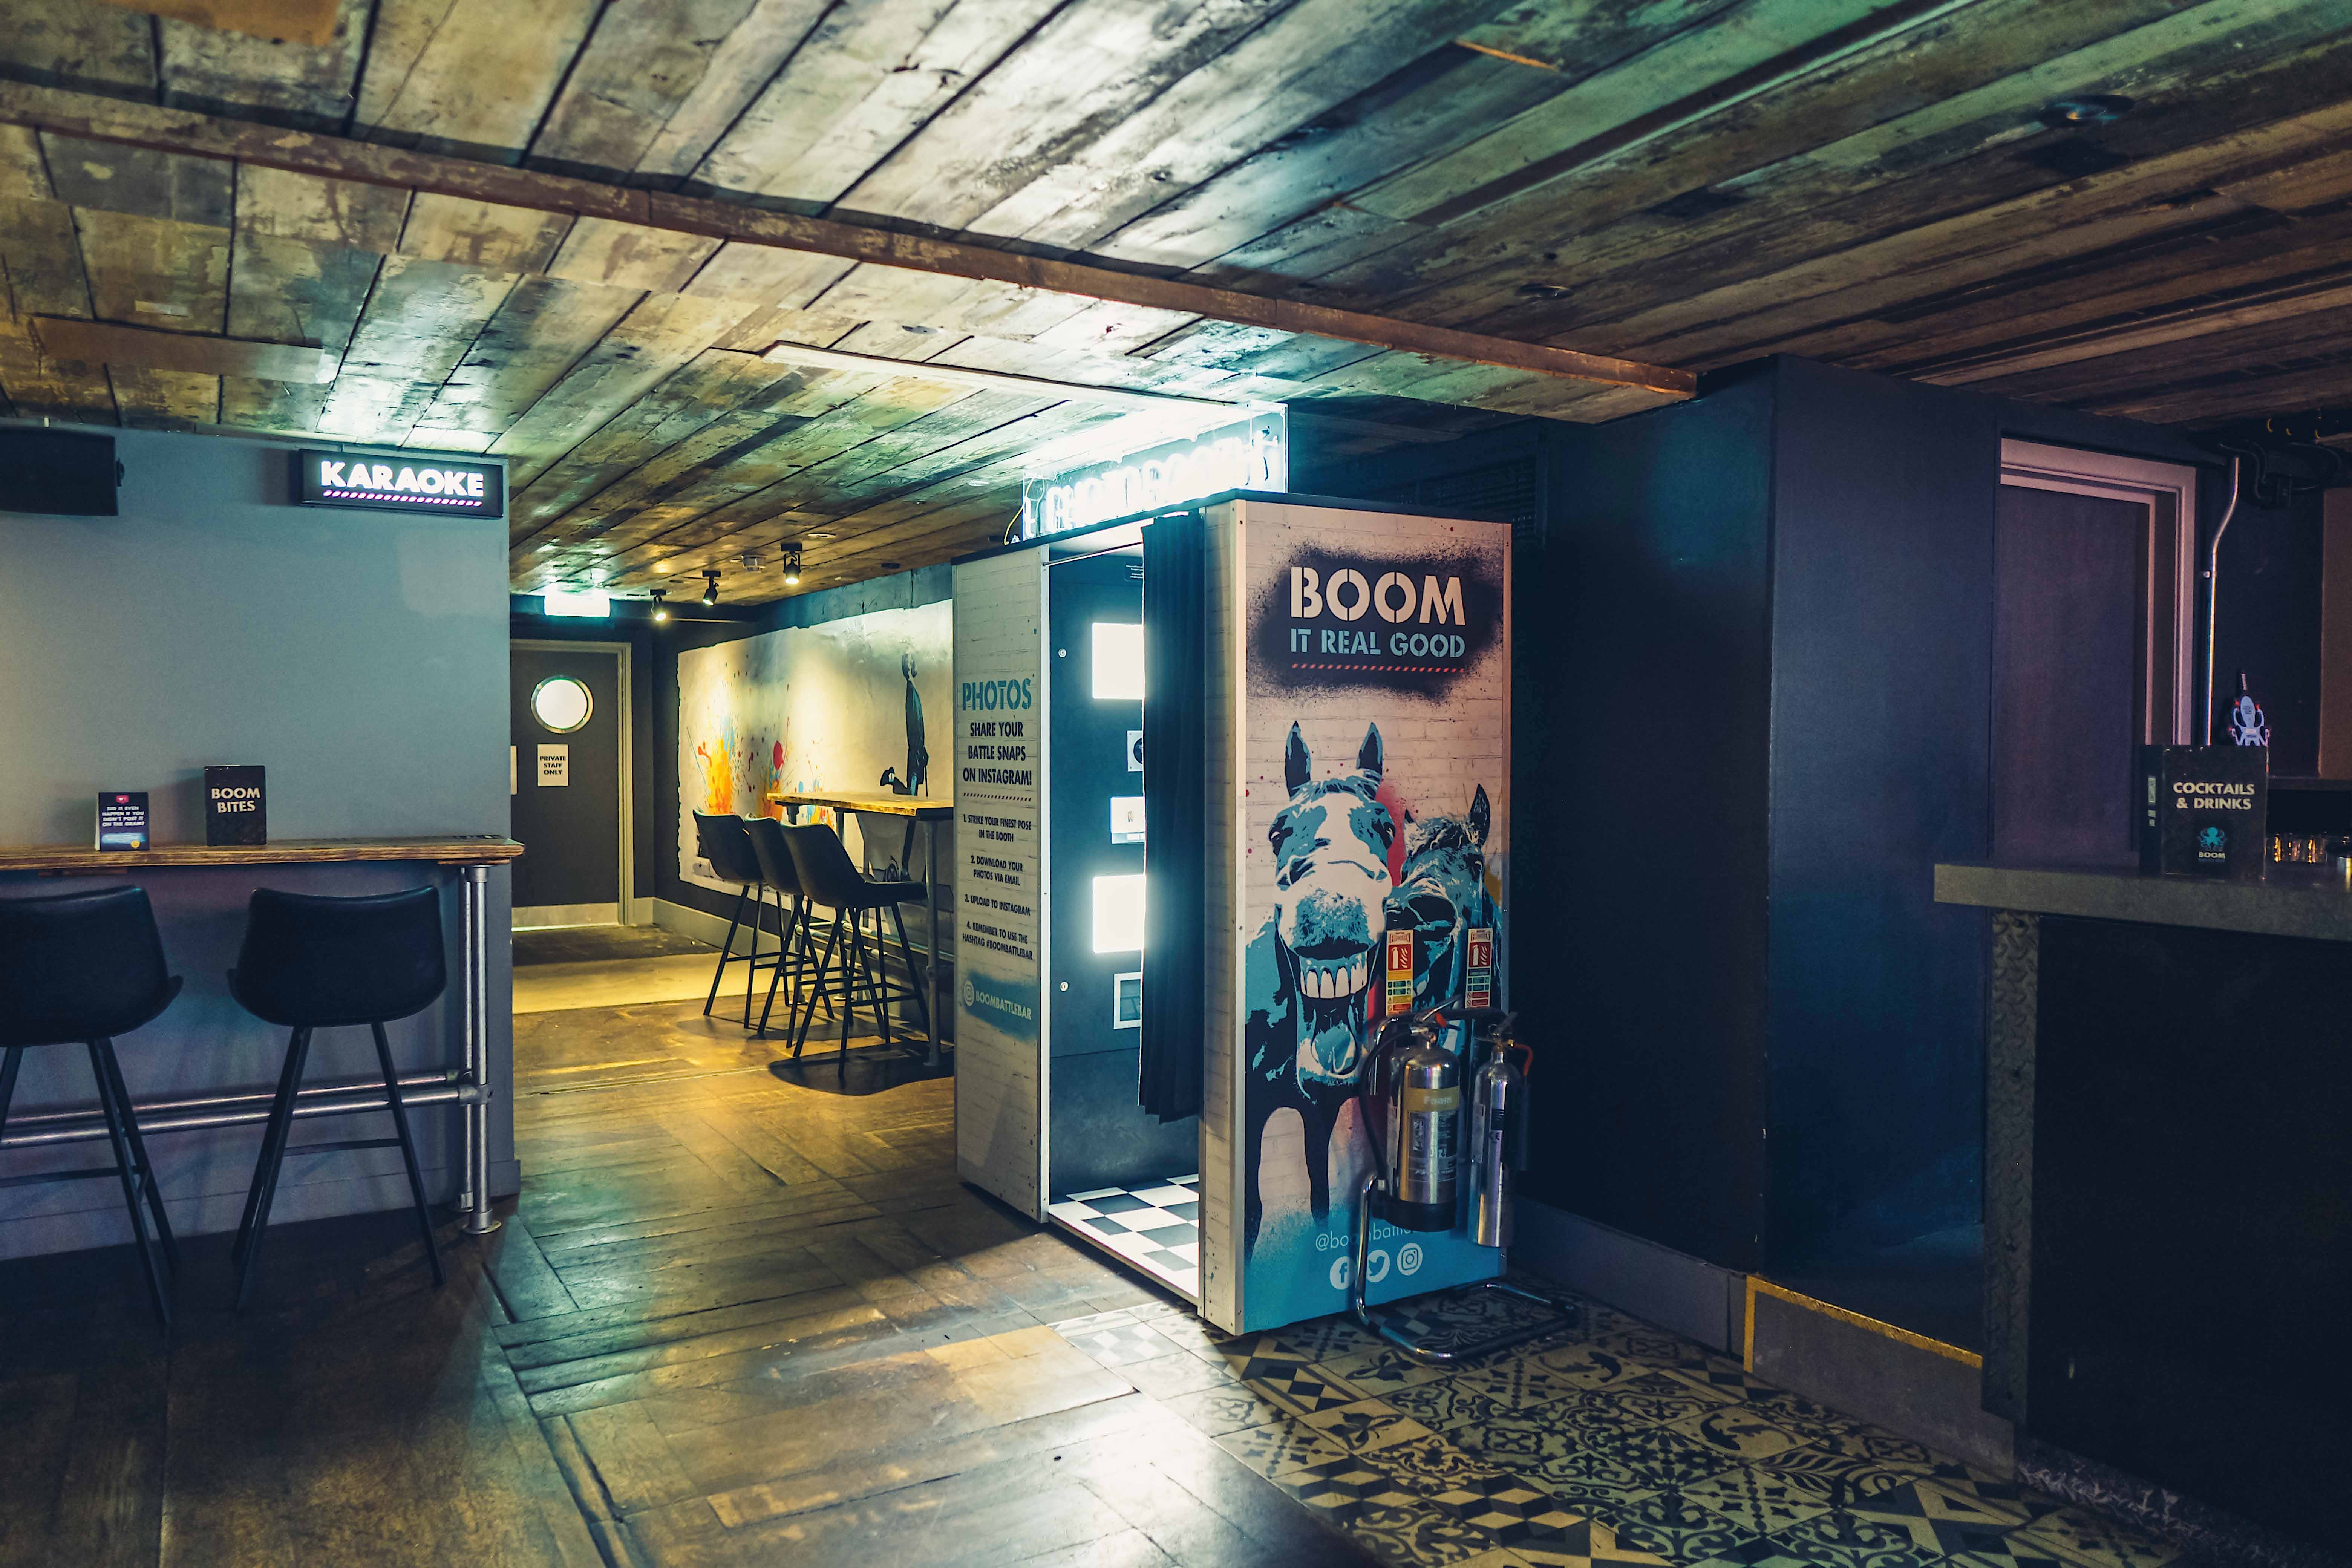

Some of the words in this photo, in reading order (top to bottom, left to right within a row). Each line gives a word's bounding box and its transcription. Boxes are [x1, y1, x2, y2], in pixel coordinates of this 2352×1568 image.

[321, 461, 484, 497] KARAOKE
[1291, 567, 1465, 626] BOOM
[1291, 628, 1312, 653] IT
[1321, 629, 1381, 655] REAL
[1390, 632, 1465, 658] GOOD
[962, 678, 1032, 711] PHOTOS
[970, 722, 995, 737] SHARE
[998, 721, 1023, 737] YOUR
[968, 745, 995, 760] BATTLE
[997, 746, 1026, 761] SNAPS
[963, 767, 976, 782] ON
[978, 768, 1032, 785] INSTAGRAM!
[211, 787, 261, 799] BOOM
[2173, 782, 2255, 795] COCKTAILS
[217, 800, 256, 813] BITES
[2176, 798, 2188, 809] &
[2194, 798, 2252, 810] DRINKS
[963, 814, 966, 822] 1.
[968, 815, 983, 825] STRIKE
[985, 816, 998, 826] YOUR
[1000, 818, 1017, 828] FINEST
[1018, 820, 1032, 830] POSE
[979, 830, 984, 838] IN
[986, 830, 994, 839] THE
[996, 832, 1014, 842] BOOTH
[971, 855, 975, 864] 2.
[977, 856, 1006, 869] DOWNLOAD
[1008, 862, 1023, 872] YOUR
[974, 869, 993, 880] PHOTOS
[994, 872, 1003, 882] VIA
[1005, 875, 1020, 886] EMAIL
[965, 893, 969, 902] 3.
[971, 895, 990, 906] UPLOAD
[991, 899, 998, 909] TO
[999, 901, 1031, 916] INSTAGRAM
[966, 921, 971, 929] 4.
[973, 922, 998, 936] REMEMBER
[1000, 929, 1006, 938] TO
[1008, 931, 1017, 941] USE
[1018, 933, 1028, 944] THE
[962, 933, 985, 946] HASHTAG
[986, 939, 1033, 960] #BOOMBATTLEBAR
[976, 991, 1032, 1020] BOOMBATTLEBAR
